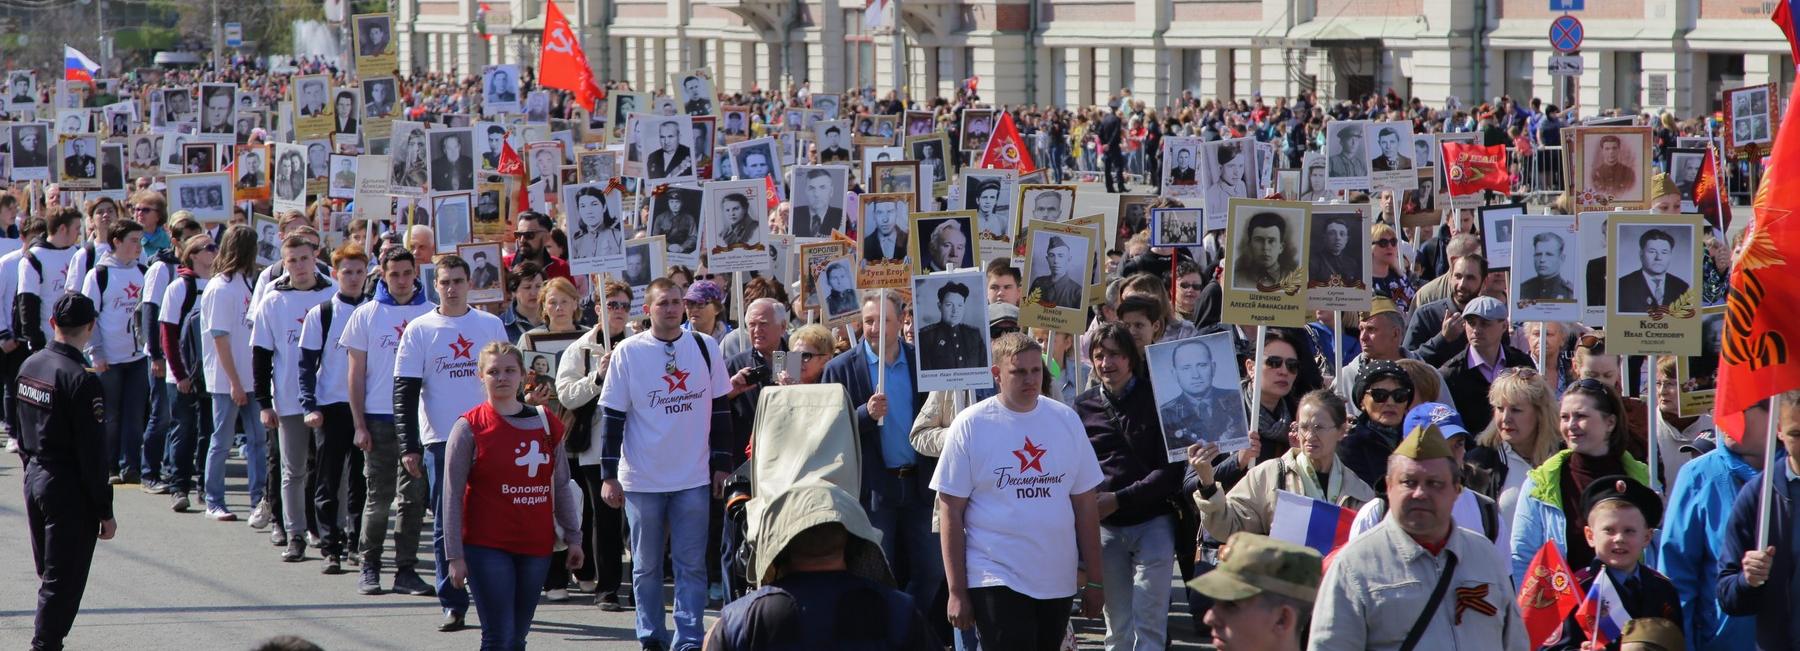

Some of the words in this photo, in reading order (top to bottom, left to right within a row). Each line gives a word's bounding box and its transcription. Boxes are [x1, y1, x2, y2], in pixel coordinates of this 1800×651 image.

[450, 369, 476, 379] ПОЛК
[18, 382, 50, 404] ПОЛИЦИЯ
[665, 402, 693, 414] ПОЛК
[993, 466, 1066, 490] Бессмертный
[1016, 487, 1052, 499] ПОЛК
